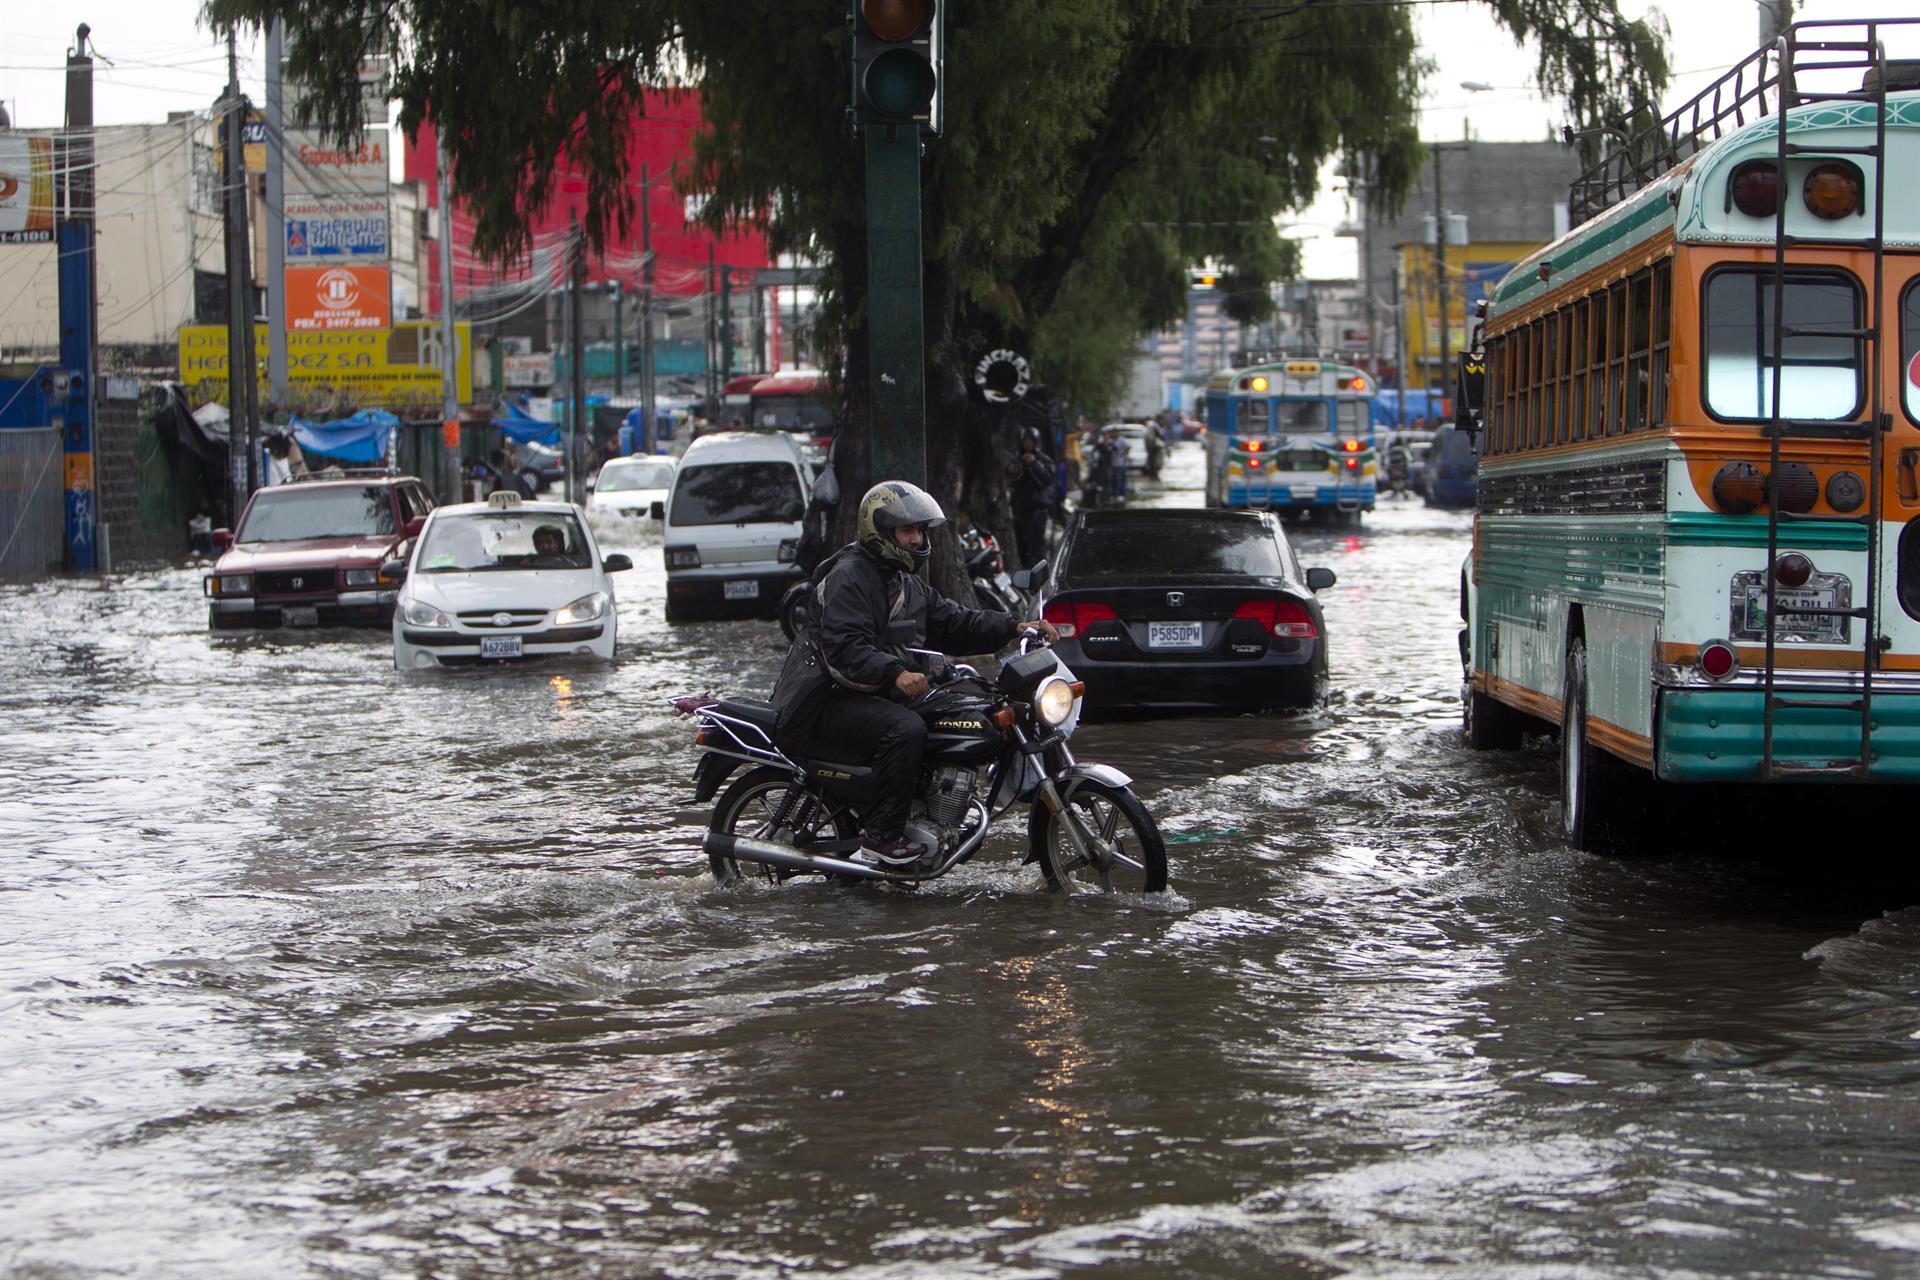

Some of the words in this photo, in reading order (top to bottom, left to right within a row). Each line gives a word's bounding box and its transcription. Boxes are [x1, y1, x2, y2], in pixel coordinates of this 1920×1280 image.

[187, 333, 377, 347] Disbuidora
[187, 352, 329, 370] HEDEZ
[1151, 627, 1200, 642] P585DPW
[936, 720, 983, 729] HONDA
